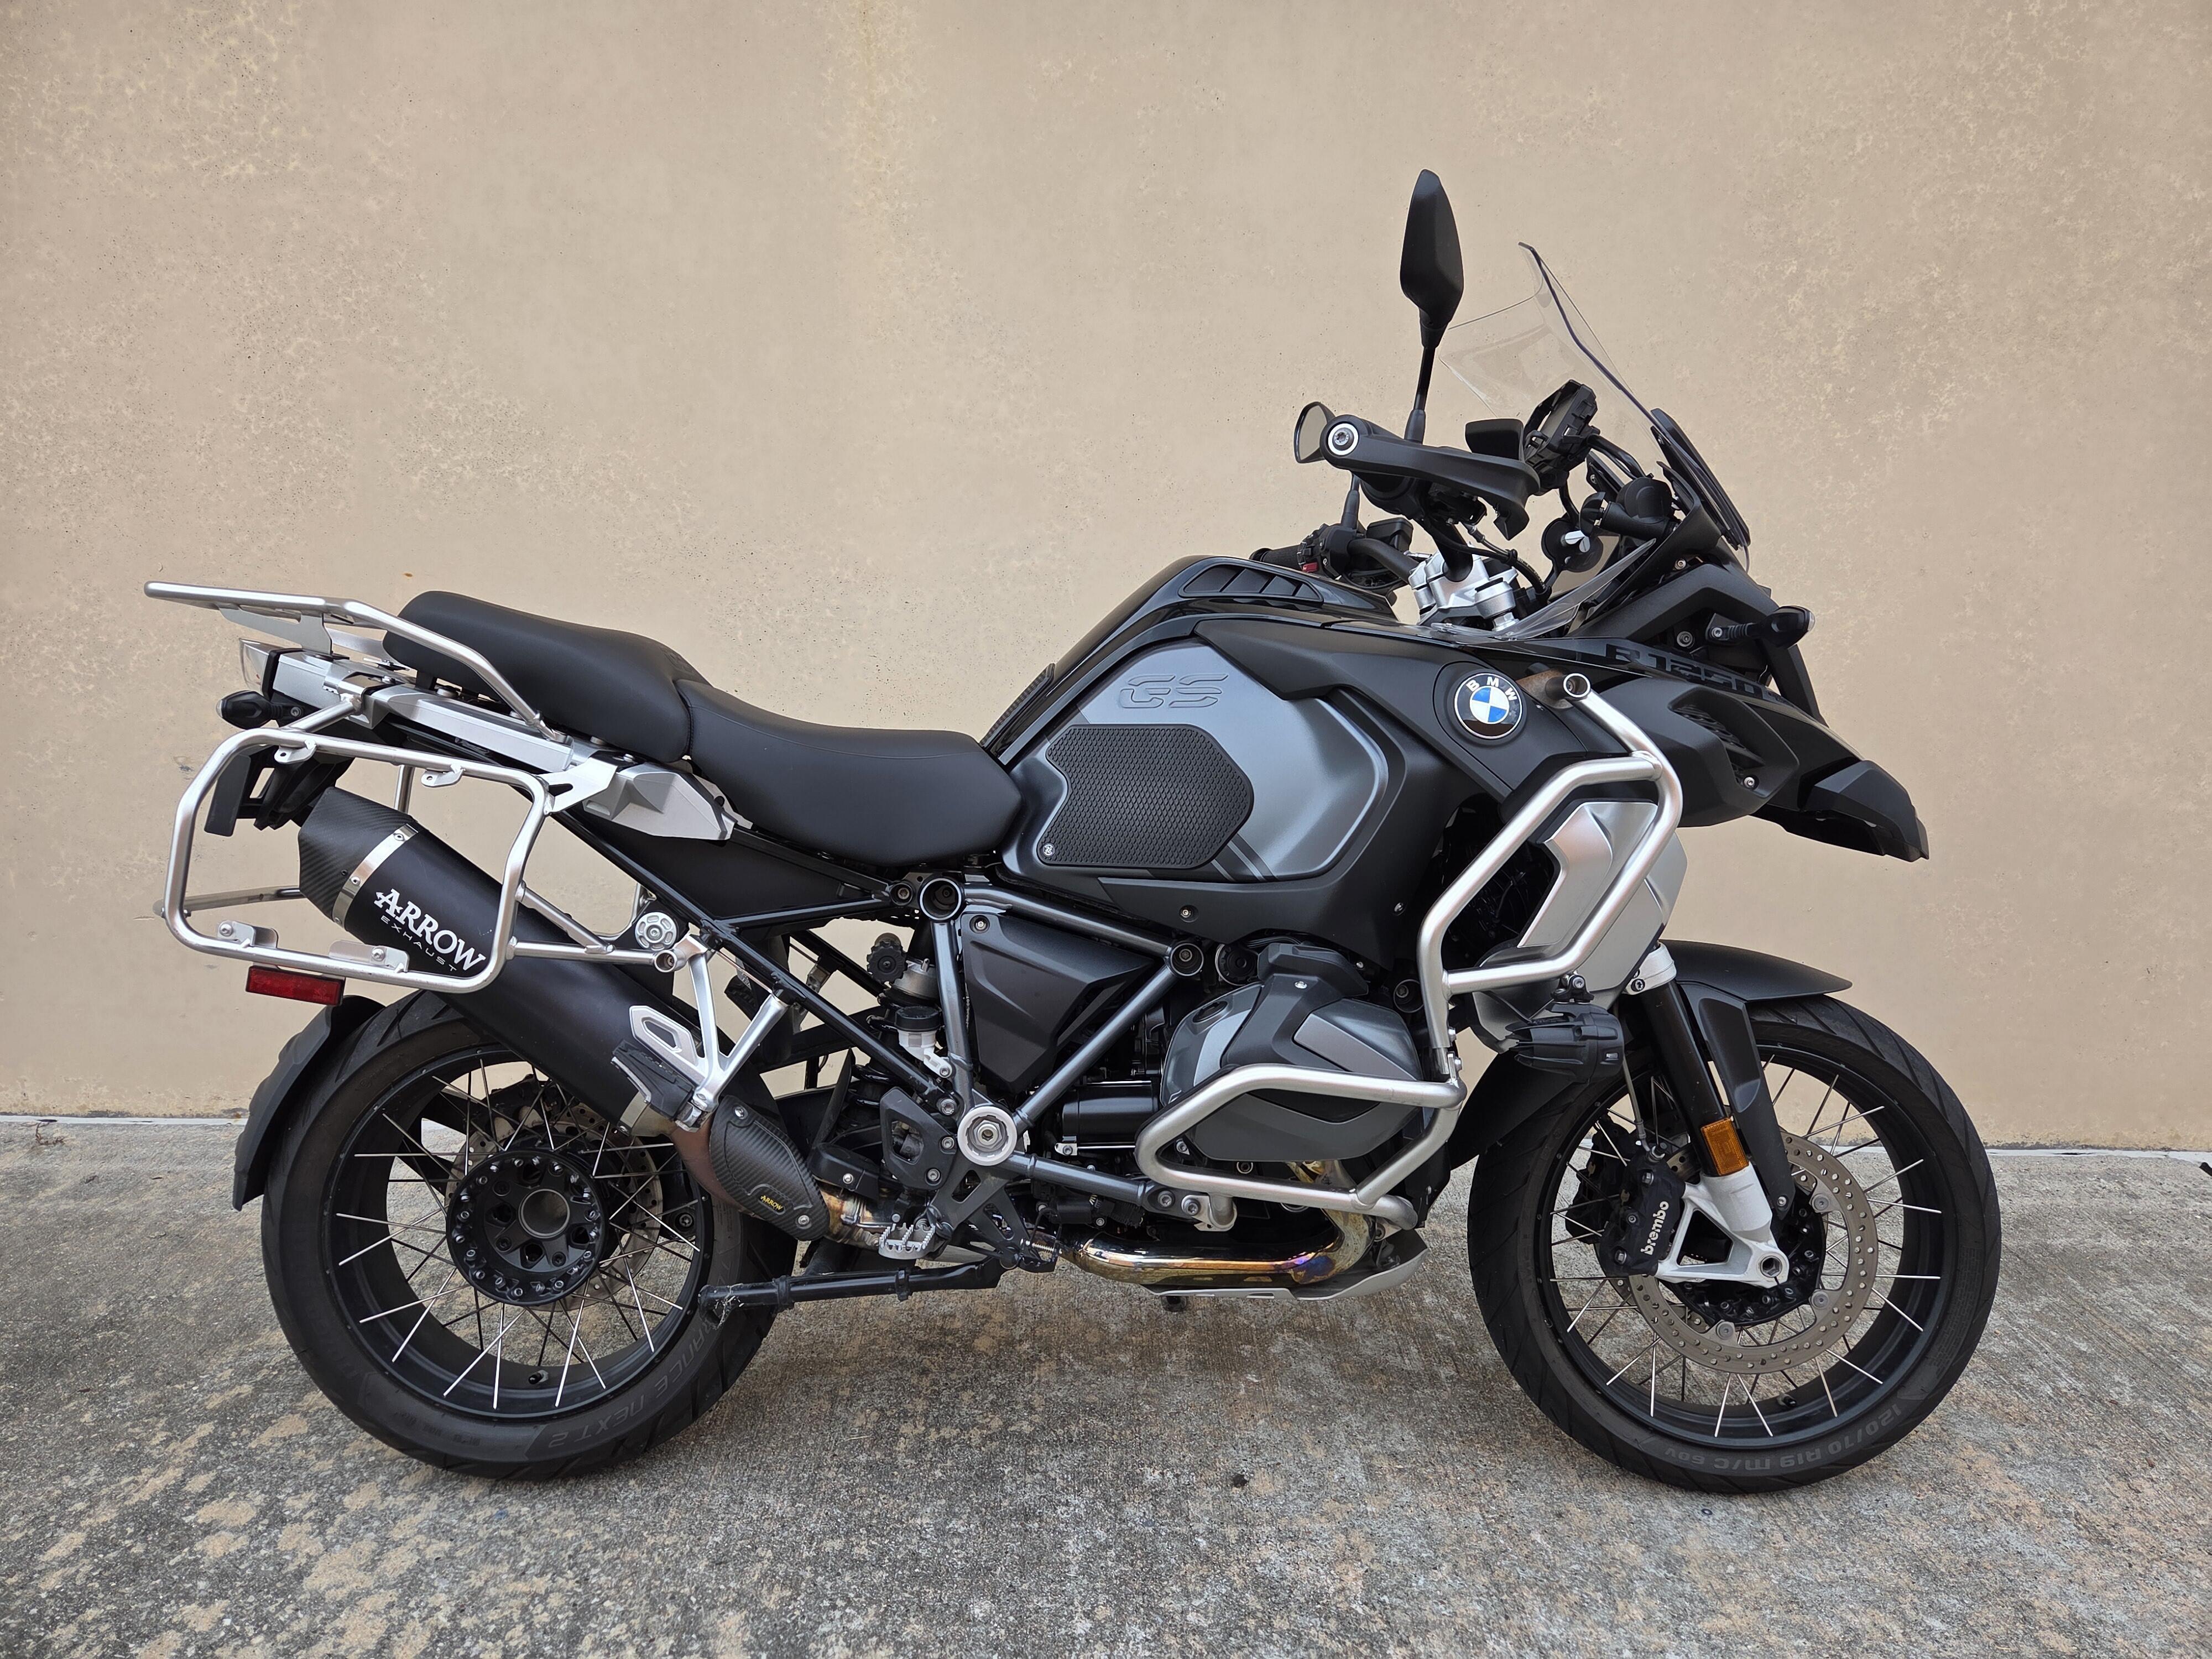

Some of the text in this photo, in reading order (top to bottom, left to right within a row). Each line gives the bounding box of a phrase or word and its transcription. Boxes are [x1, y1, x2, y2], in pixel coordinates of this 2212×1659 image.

[1118, 674, 1229, 708] GS
[1466, 676, 1517, 701] BMW
[374, 888, 486, 971] ARROW
[380, 915, 457, 972] EXHAUST
[760, 1195, 783, 1210] ARROW
[1640, 1201, 1669, 1255] brembo
[548, 1431, 568, 1448] 2
[574, 1395, 644, 1442] NEXT
[1664, 1402, 1902, 1471] 120/70 R19 M/C 60V
